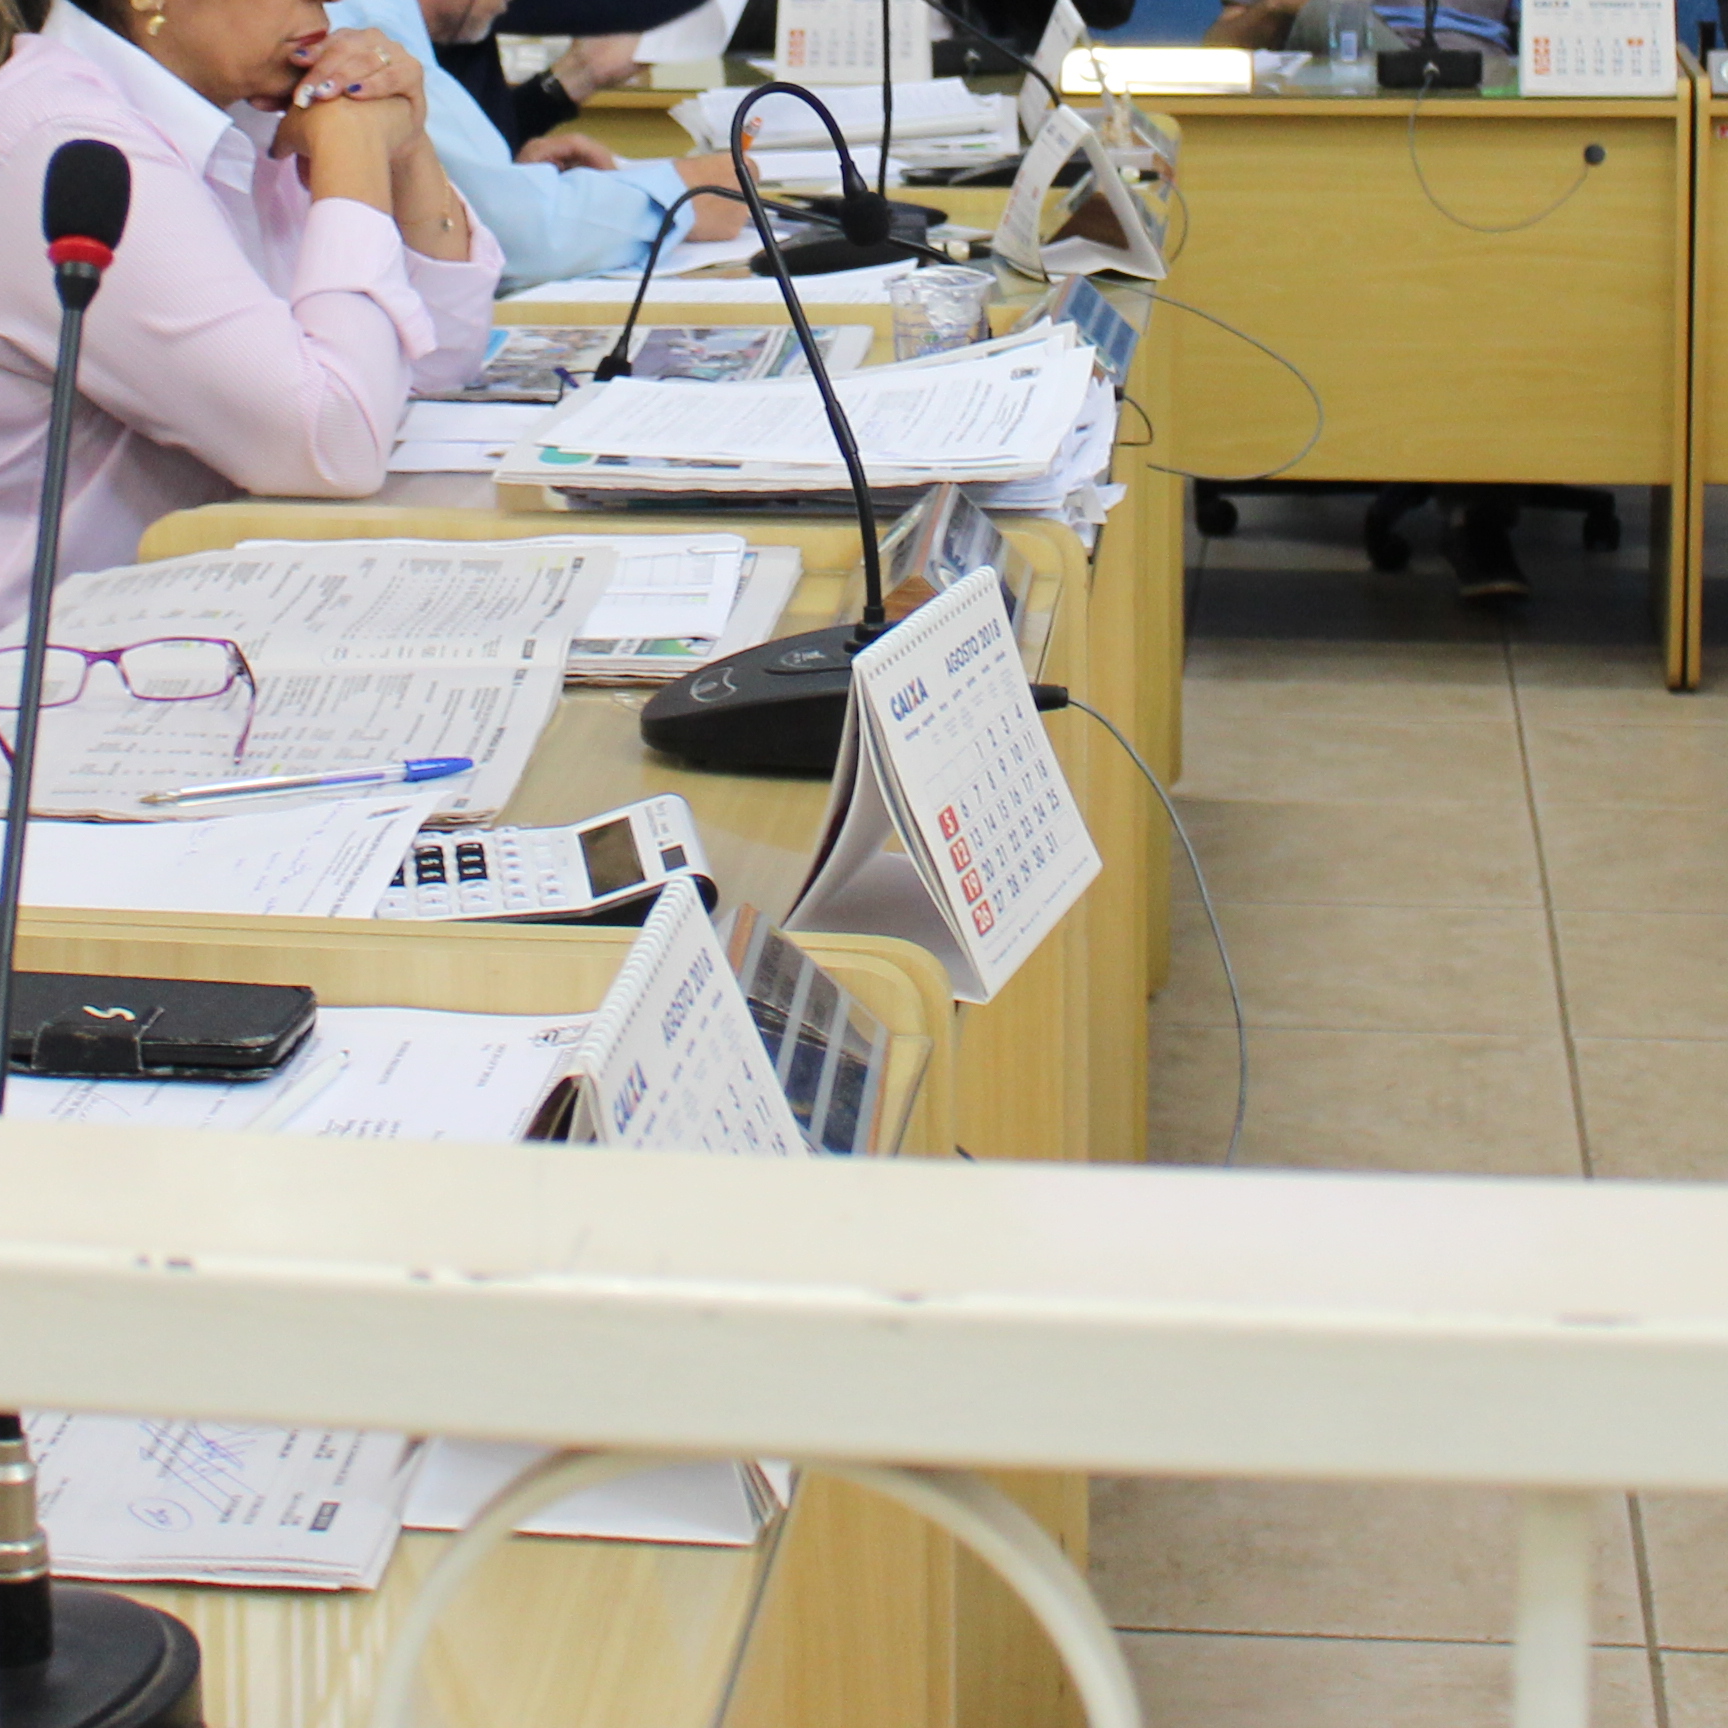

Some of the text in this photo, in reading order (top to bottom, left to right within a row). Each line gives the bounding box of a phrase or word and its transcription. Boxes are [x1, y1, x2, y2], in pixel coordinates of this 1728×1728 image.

[891, 677, 929, 722] CAIXA
[945, 635, 979, 674] AGOSTO
[977, 618, 1001, 649] 2018
